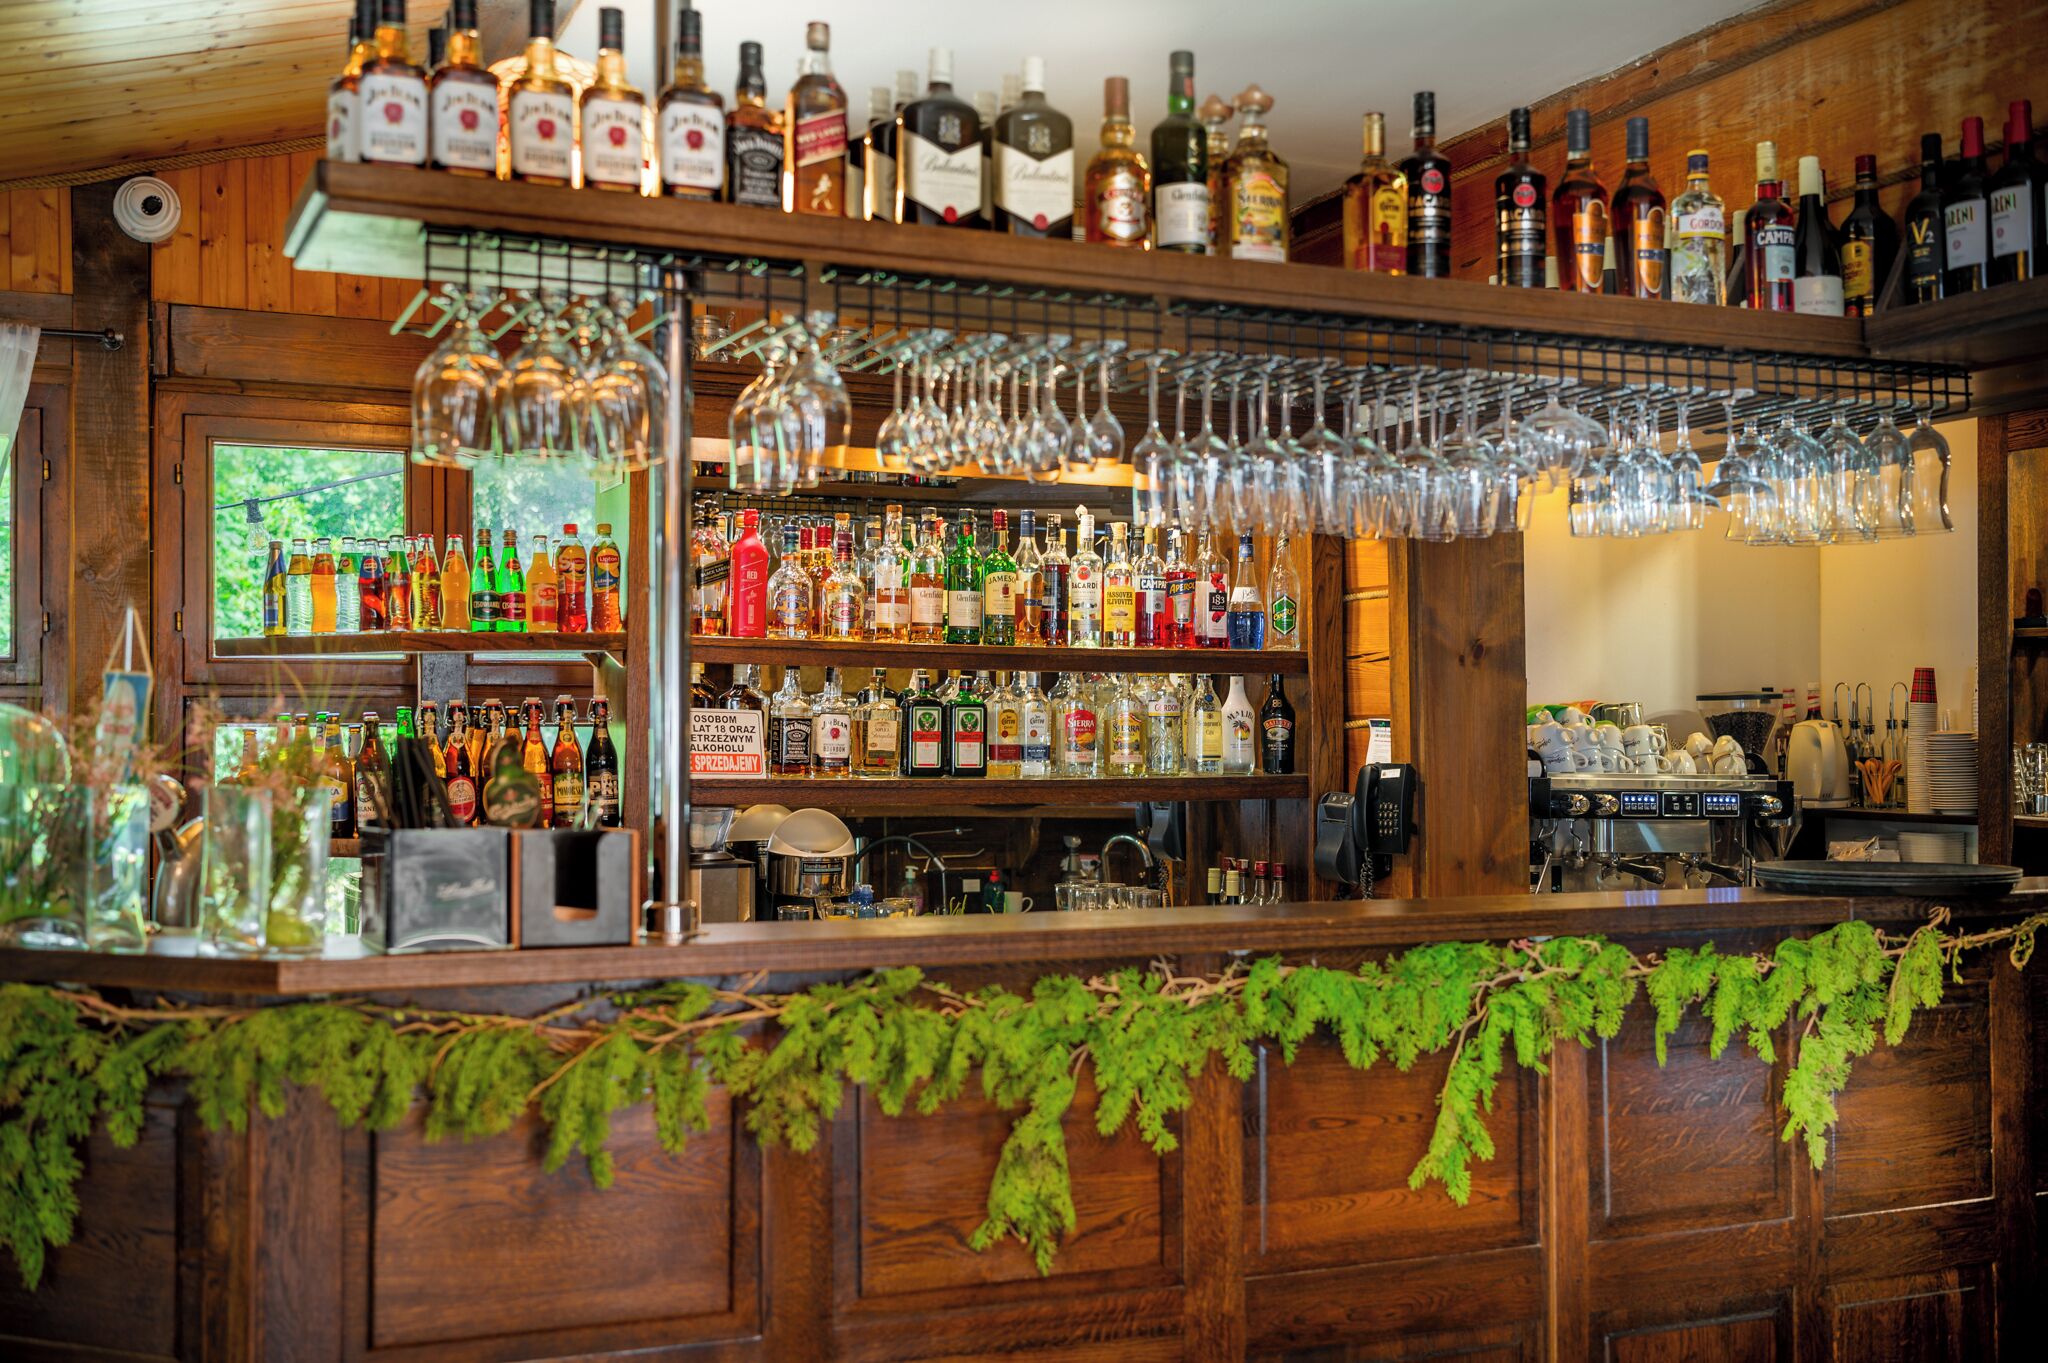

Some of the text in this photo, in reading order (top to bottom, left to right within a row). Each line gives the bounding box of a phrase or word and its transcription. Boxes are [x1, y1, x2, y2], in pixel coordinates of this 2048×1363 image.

[1757, 229, 1795, 245] CAMPA
[746, 571, 758, 579] RED
[988, 575, 1016, 584] JAMESO
[1141, 579, 1166, 589] CAMPA
[693, 714, 737, 723] OSOBOM
[1068, 716, 1094, 728] SIERRA
[714, 725, 726, 733] 18
[729, 725, 756, 733] ORAZ
[833, 719, 847, 730] BEAM
[690, 733, 753, 743] ETRZEŹWYM
[690, 744, 744, 752] ALKOHOLU
[694, 755, 758, 771] SPRZEDAJEMY
